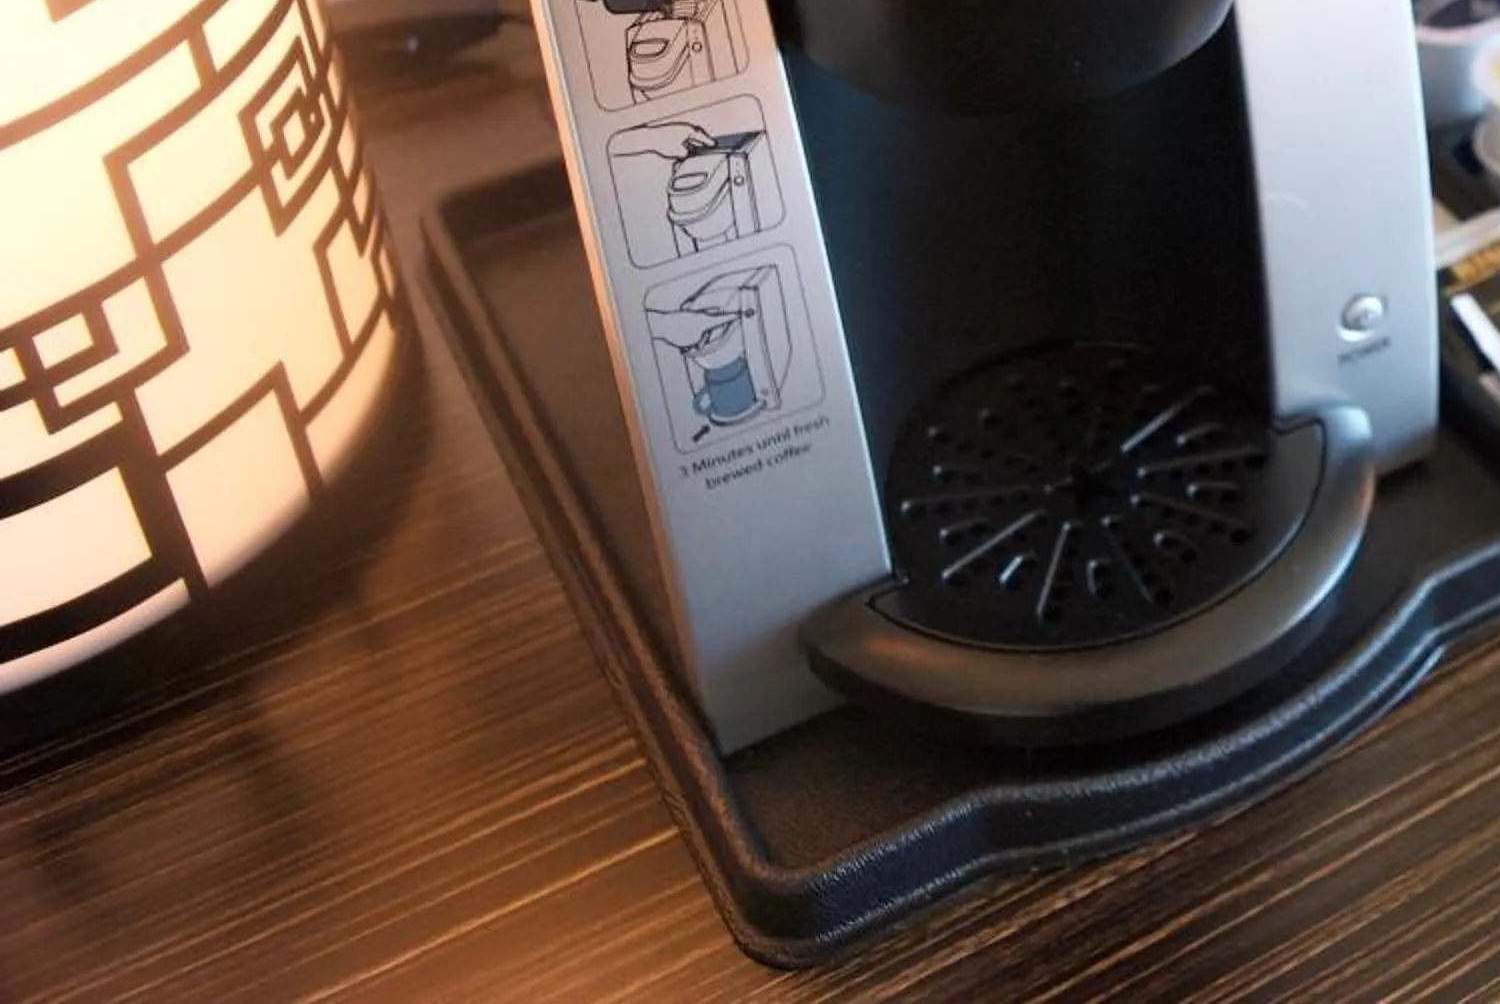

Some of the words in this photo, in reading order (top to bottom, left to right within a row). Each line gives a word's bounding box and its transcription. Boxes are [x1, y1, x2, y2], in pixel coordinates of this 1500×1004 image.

[691, 445, 754, 474] Minutes
[755, 428, 791, 450] until
[793, 415, 830, 436] fresh
[705, 457, 764, 491] brewed
[766, 444, 812, 467] coffee
